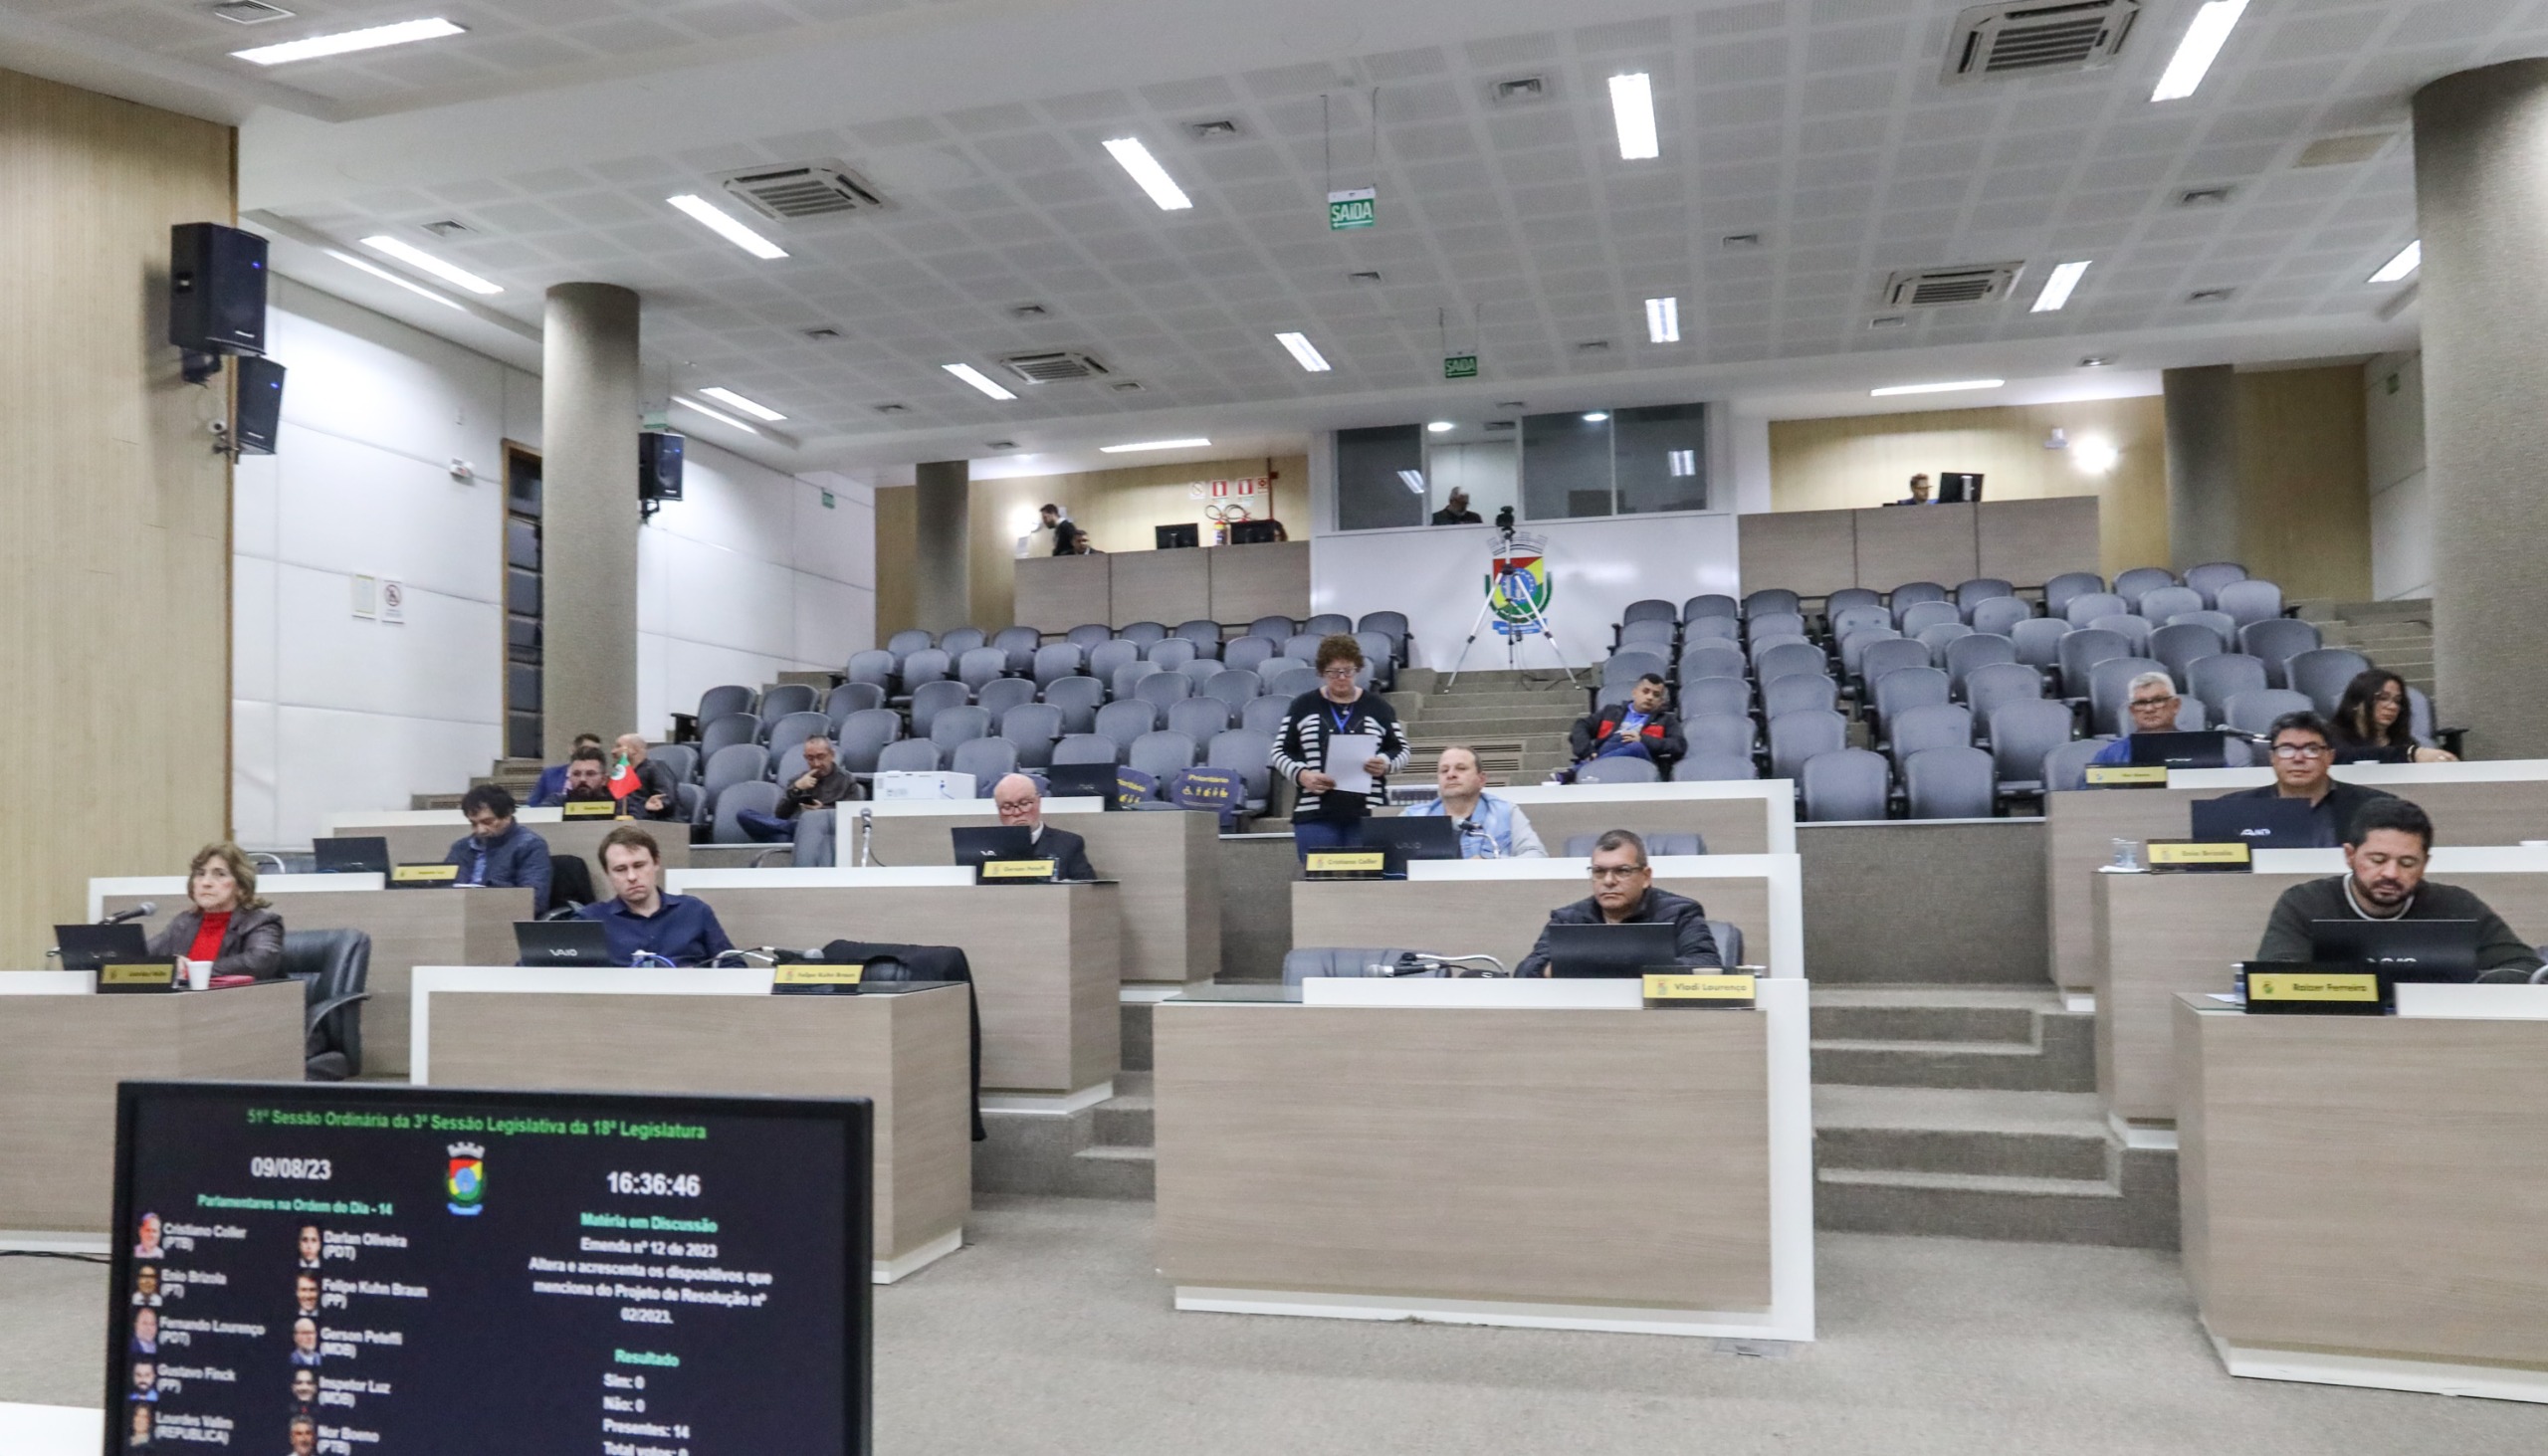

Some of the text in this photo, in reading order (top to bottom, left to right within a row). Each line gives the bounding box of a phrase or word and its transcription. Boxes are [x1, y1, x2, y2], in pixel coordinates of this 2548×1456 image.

[271, 1110, 321, 1126] Sessão
[324, 1111, 389, 1129] Ordinária
[391, 1114, 410, 1129] da
[431, 1115, 485, 1131] Sessão
[486, 1117, 566, 1136] Legislativa
[568, 1120, 588, 1135] da
[619, 1121, 707, 1141] Legislatura
[251, 1156, 332, 1180] 09/08/23
[606, 1170, 701, 1196] 16:36:46
[198, 1194, 275, 1209] Parlamentares
[349, 1201, 370, 1214] Dia
[380, 1202, 393, 1215] 14
[628, 1217, 650, 1229] em
[650, 1215, 719, 1233] Discussão
[580, 1237, 633, 1253] Emenda
[650, 1240, 666, 1255] 12
[667, 1242, 685, 1256] de
[686, 1242, 718, 1258] 2023
[647, 1266, 665, 1278] os
[745, 1272, 773, 1287] que
[613, 1284, 661, 1302] Projeto
[661, 1287, 680, 1302] de
[680, 1288, 750, 1308] Resolução
[614, 1349, 681, 1367] Resultado
[634, 1375, 646, 1390] 0
[634, 1398, 646, 1414] 0
[602, 1418, 691, 1439] Presentes: 14
